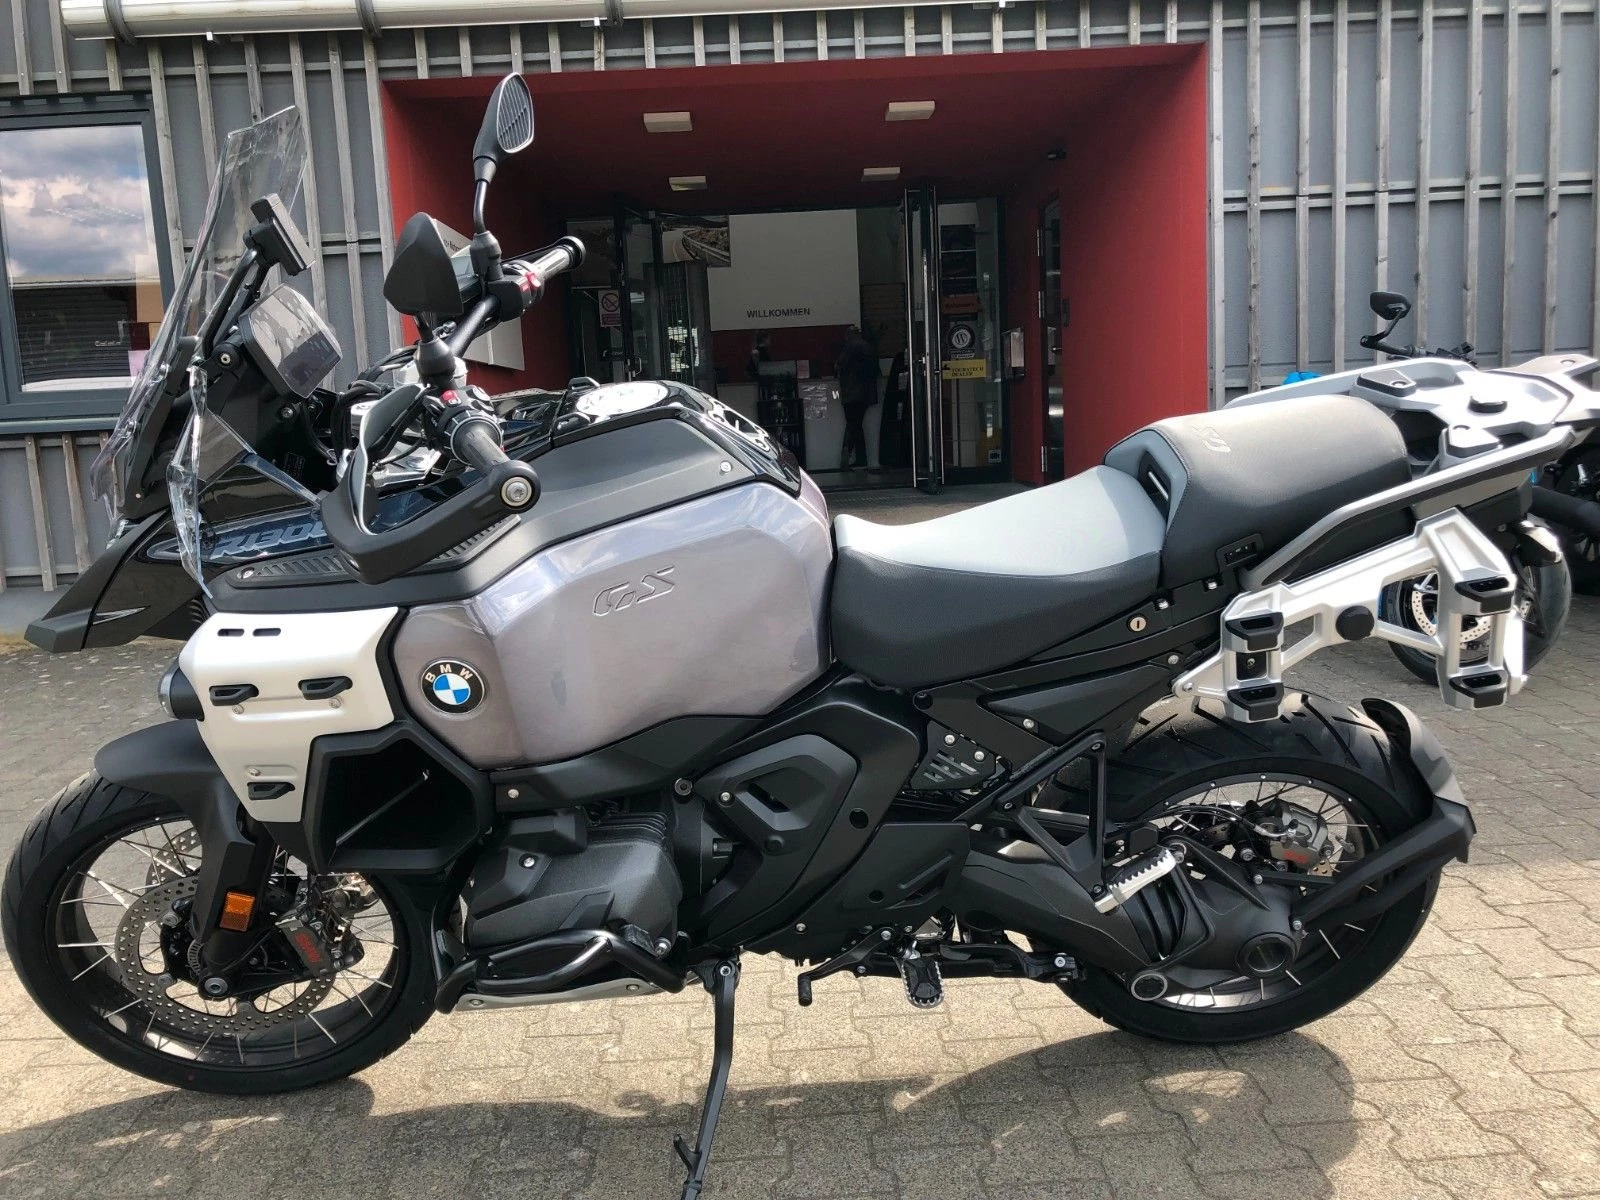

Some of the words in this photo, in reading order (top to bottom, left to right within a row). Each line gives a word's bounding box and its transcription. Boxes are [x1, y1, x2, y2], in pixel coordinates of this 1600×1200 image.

[746, 308, 811, 318] WILLKOMMEN
[592, 563, 676, 617] GS
[424, 663, 474, 683] BMW
